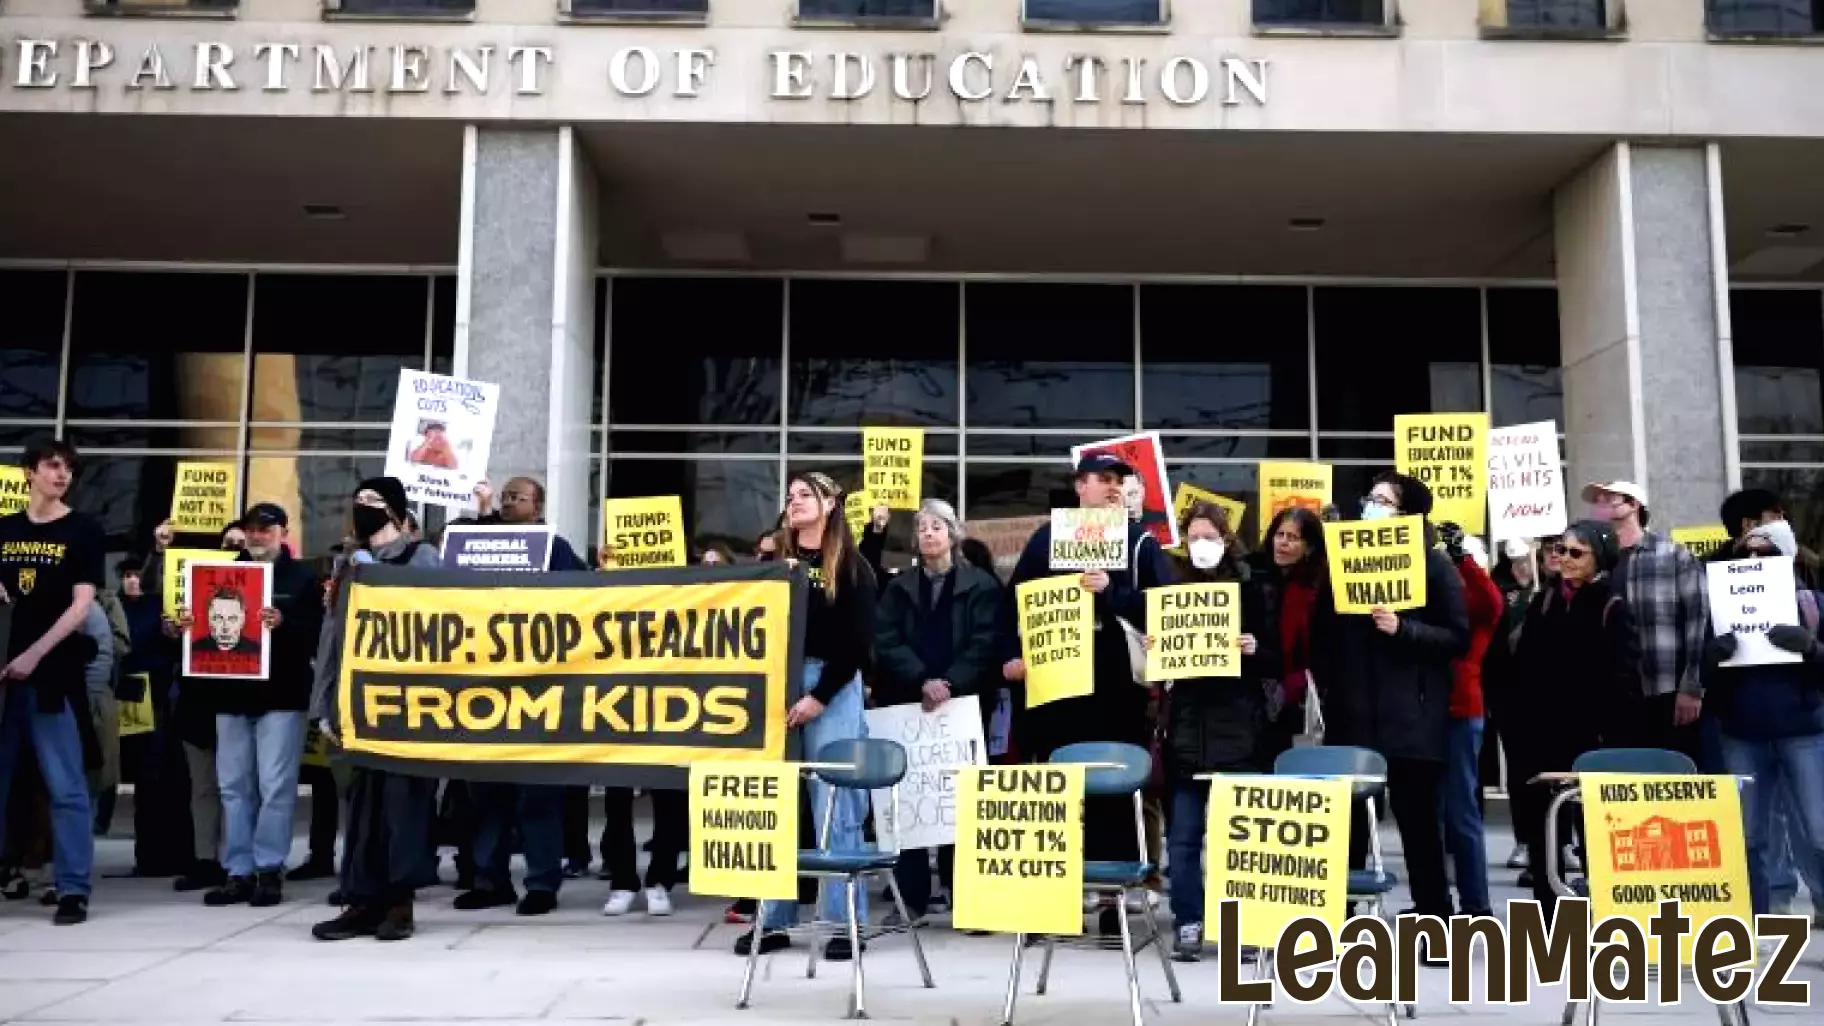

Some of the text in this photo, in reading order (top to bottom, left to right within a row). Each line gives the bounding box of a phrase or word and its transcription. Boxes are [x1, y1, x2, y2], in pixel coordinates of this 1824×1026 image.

[0, 38, 1271, 107] EPARTMENT OF EDUCATION
[417, 397, 447, 413] CUTS
[1406, 424, 1474, 443] FUND
[868, 437, 912, 452] FUND
[1406, 446, 1475, 462] EDUCATION
[1487, 451, 1549, 471] CIVIL
[184, 469, 227, 484] FUND
[1408, 465, 1474, 482] NOT 1%
[1490, 470, 1554, 490] RIGHTS
[1437, 485, 1473, 499] CUTS
[179, 500, 204, 514] NOT
[1502, 502, 1553, 520] NOW!
[615, 511, 671, 529] TRUMP:
[615, 529, 674, 550] STOP
[1339, 525, 1410, 549] FREE
[1727, 561, 1763, 574] Send
[1024, 587, 1081, 611] FUND
[1161, 590, 1230, 611] FUND
[1345, 578, 1412, 605] KHALIL
[1741, 604, 1758, 615] to
[1161, 612, 1230, 631] EDUCATION
[354, 606, 766, 664] TRUMP: STOP STEALING
[1028, 626, 1081, 652] NOT 1%
[1161, 632, 1230, 653] NOT 1%
[1050, 645, 1081, 662] CUTS
[1161, 653, 1230, 670] TAX CUTS
[363, 684, 750, 735] FROM KIDS
[702, 774, 778, 799] FREE
[977, 769, 1067, 794] FUND
[1600, 779, 1718, 802] KIDS DESERVE
[1232, 784, 1331, 814] TRUMP:
[976, 799, 1067, 823] EDUCATION
[976, 827, 1067, 852] NOT 1%
[1228, 815, 1330, 848] STOP
[702, 839, 778, 872] KHALIL
[1226, 849, 1329, 881] DEFUNDING
[976, 857, 1067, 878] TAX CUTS
[1225, 880, 1327, 908] OUR FUTURES
[1612, 881, 1733, 903] GOOD SCHOOLS
